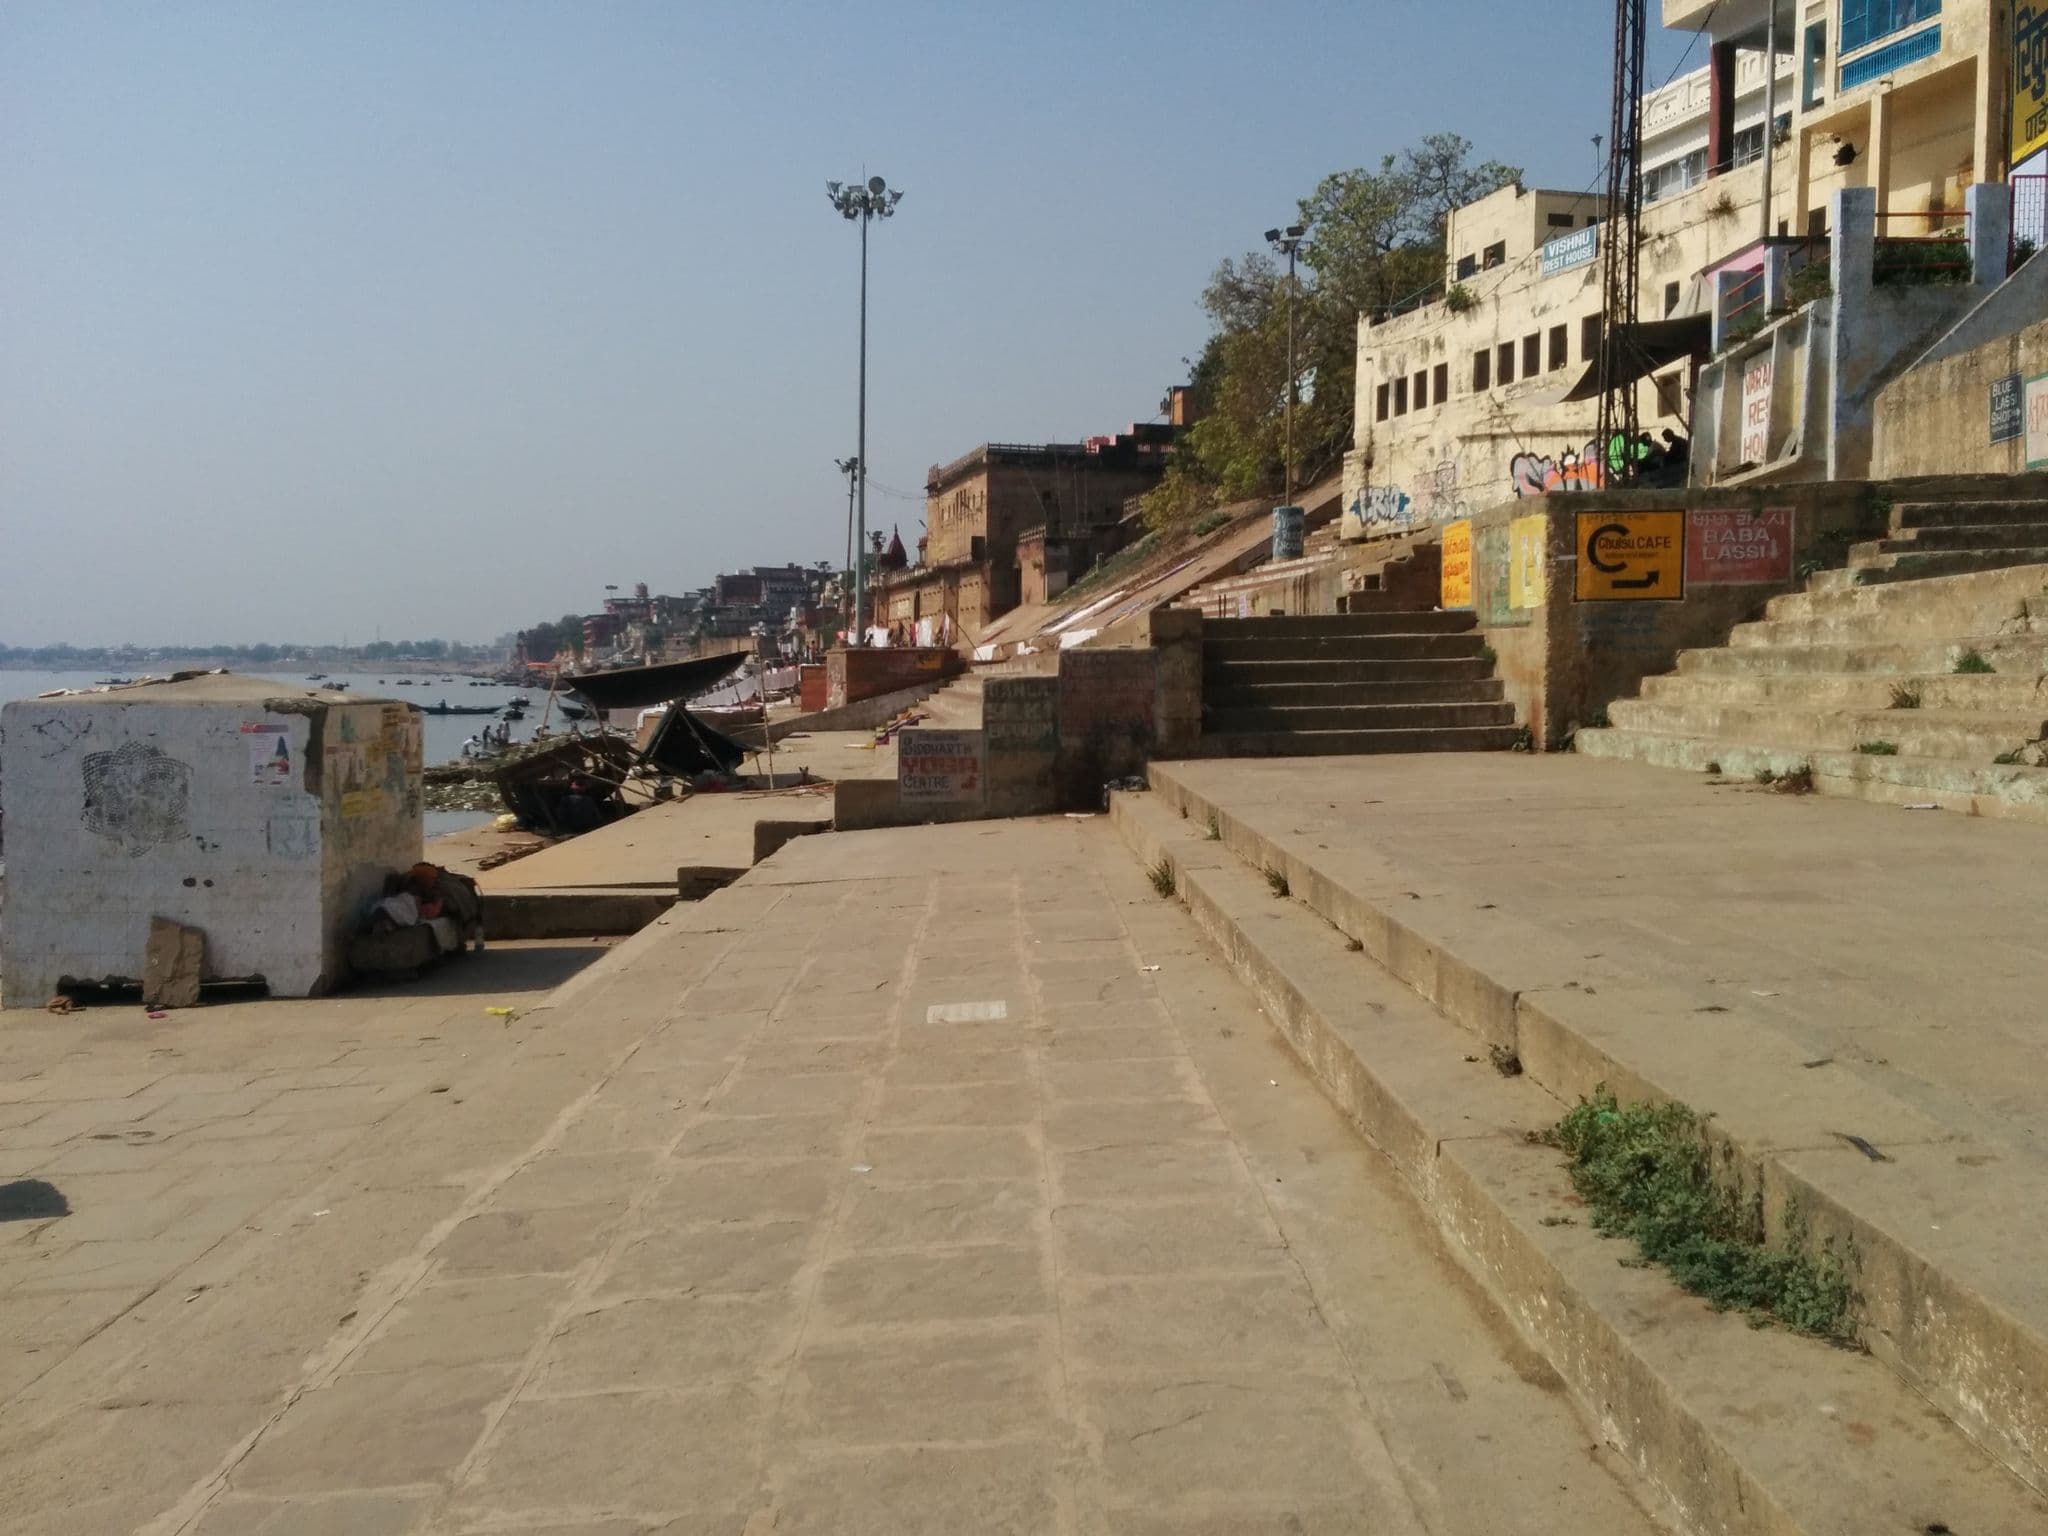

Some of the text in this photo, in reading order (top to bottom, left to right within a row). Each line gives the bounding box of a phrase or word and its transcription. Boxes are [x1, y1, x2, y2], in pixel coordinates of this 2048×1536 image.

[1549, 230, 1590, 257] VISHNU
[1543, 244, 1593, 273] REST HOUSE
[1992, 380, 2013, 398] BLUE
[1637, 535, 1672, 549] CAFE
[1704, 528, 1770, 543] BABA
[1702, 545, 1766, 561] LASSI
